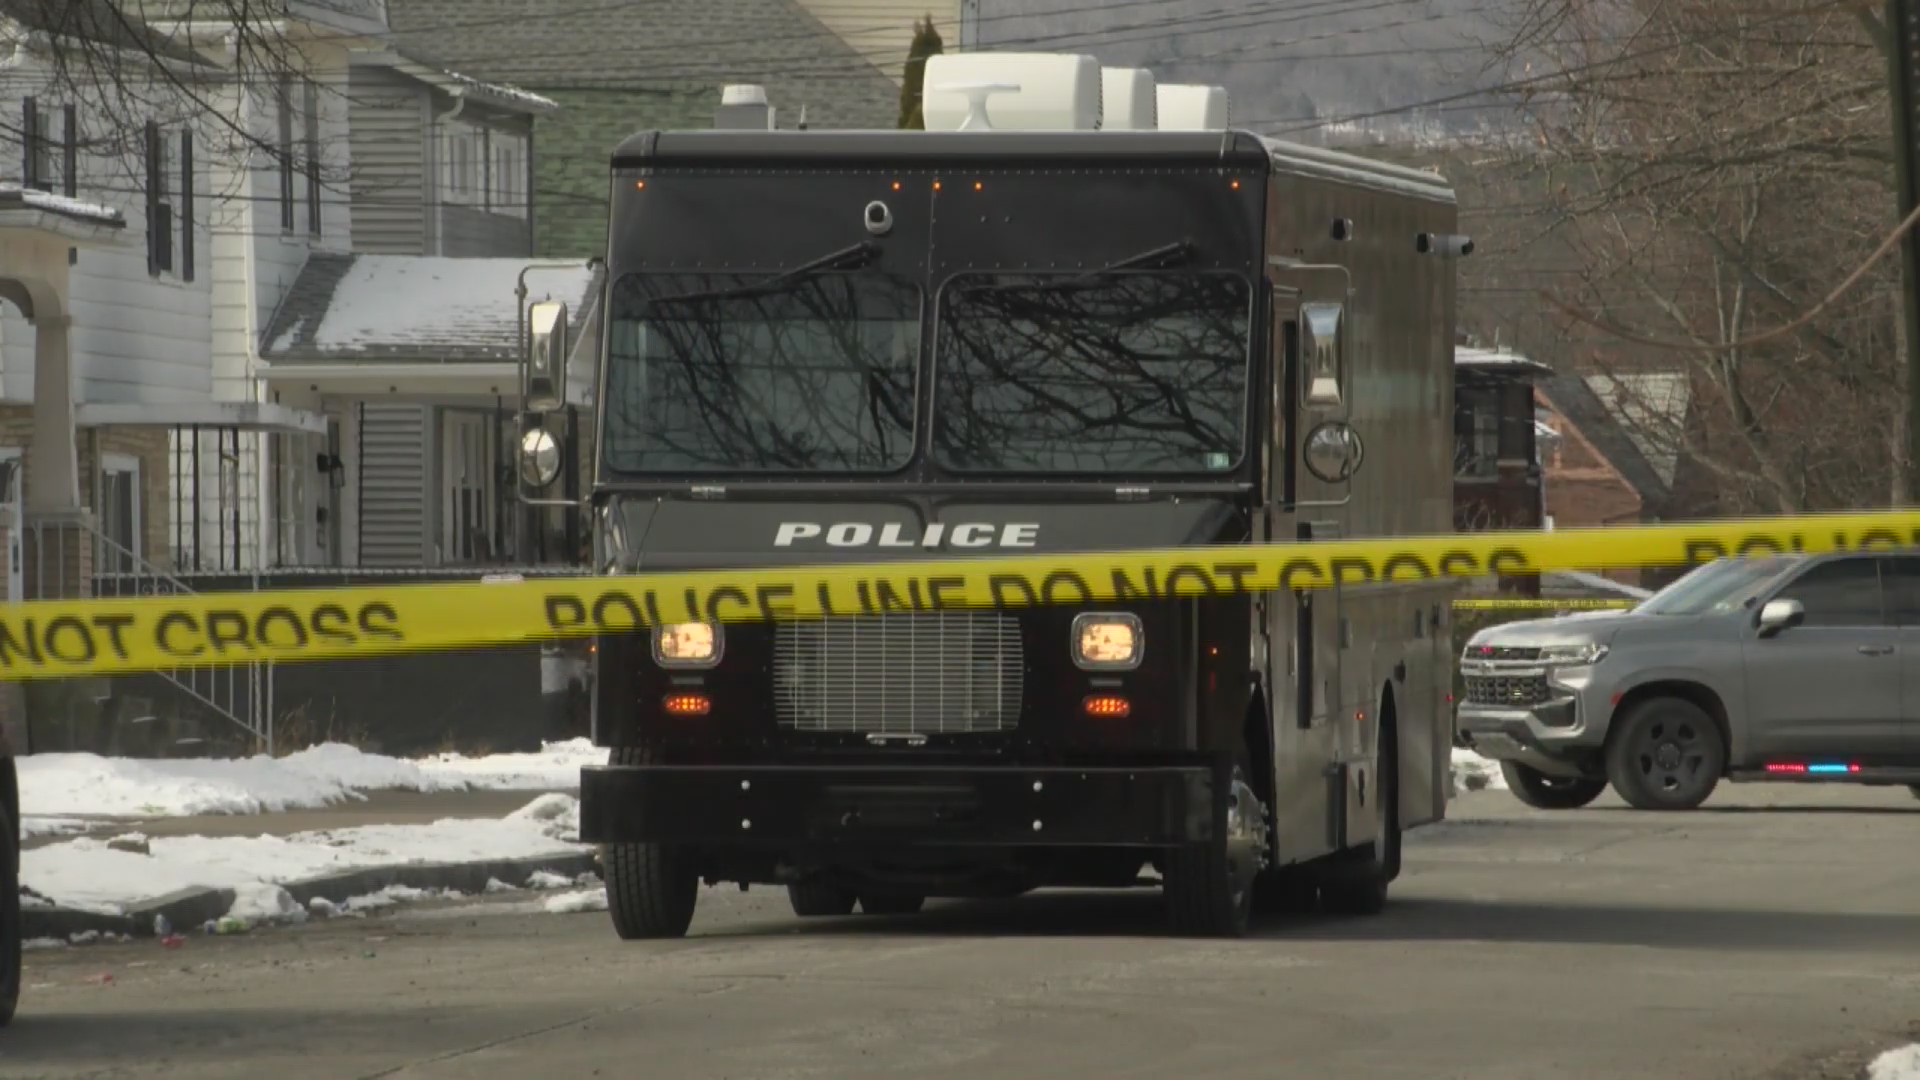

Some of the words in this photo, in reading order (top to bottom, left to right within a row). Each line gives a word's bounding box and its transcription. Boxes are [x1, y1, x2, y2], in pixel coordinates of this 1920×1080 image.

[773, 522, 1040, 546] POLICE
[0, 612, 134, 667] NOT
[155, 601, 405, 656] CROSS
[545, 582, 794, 631] POLICE
